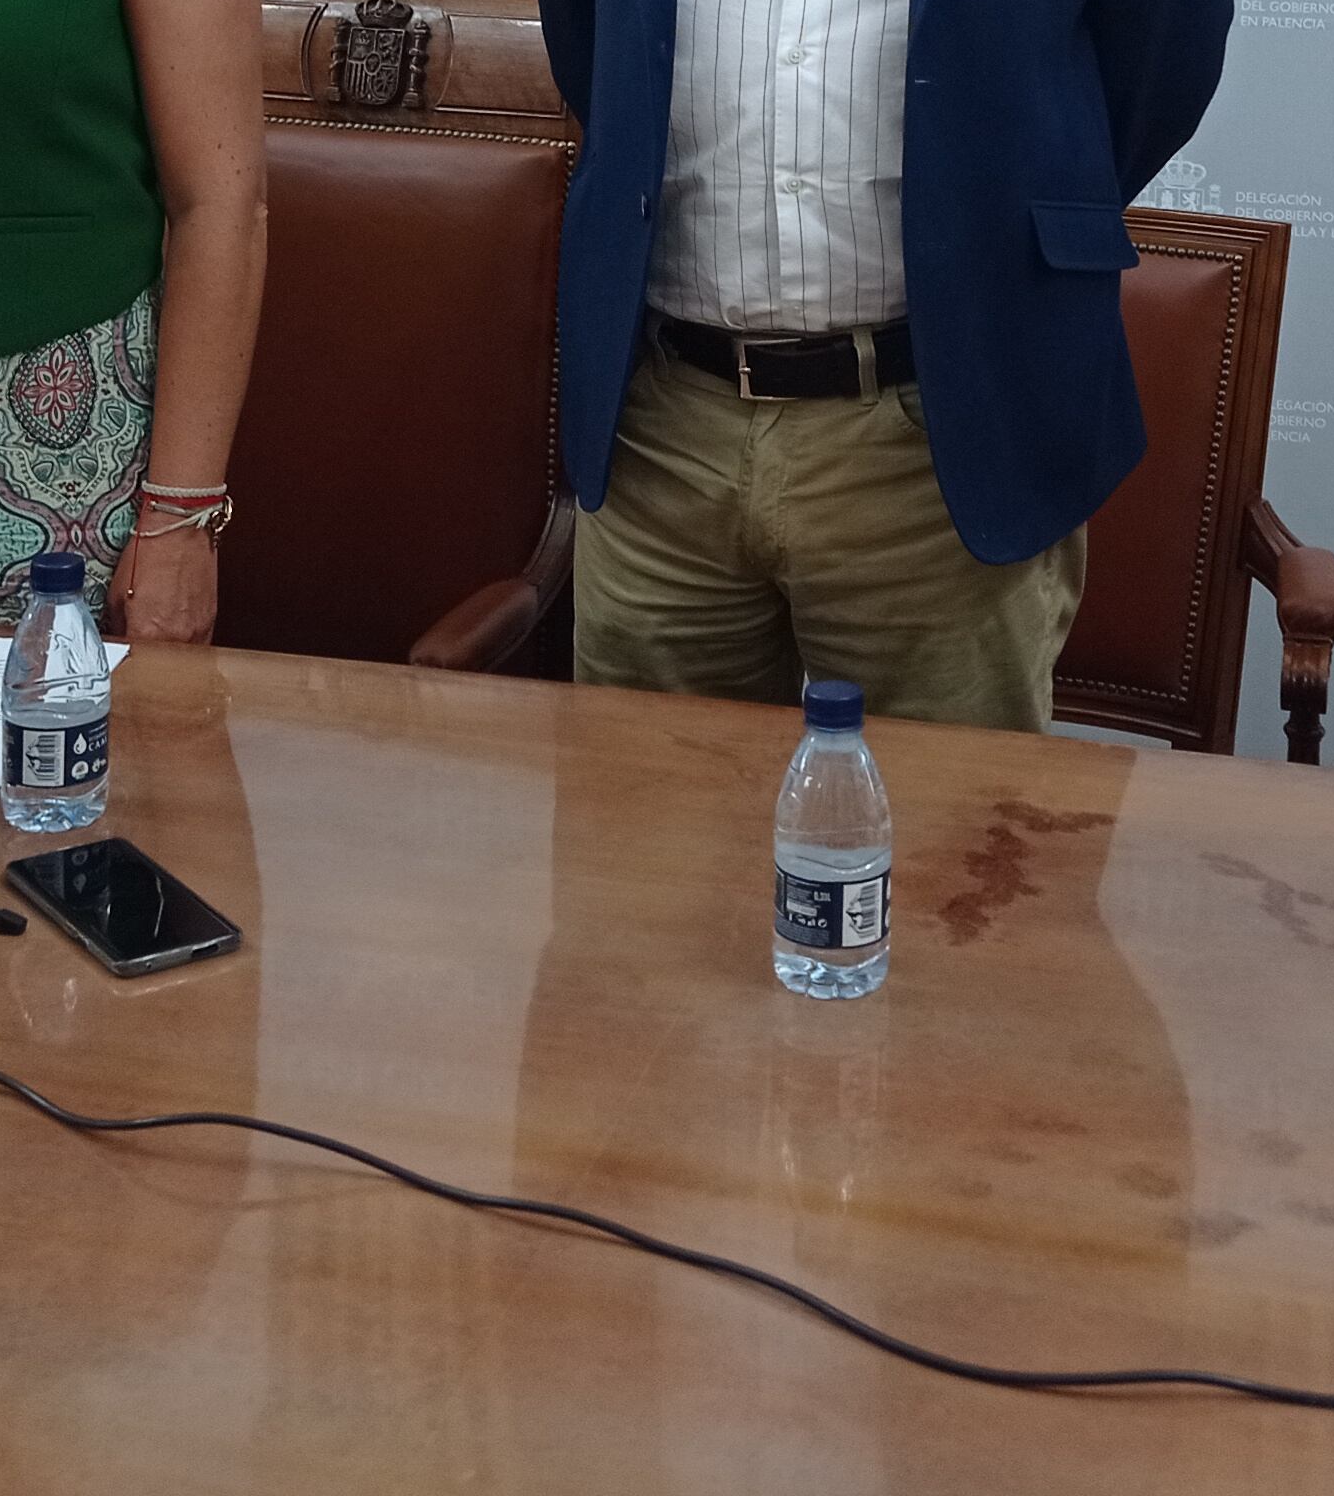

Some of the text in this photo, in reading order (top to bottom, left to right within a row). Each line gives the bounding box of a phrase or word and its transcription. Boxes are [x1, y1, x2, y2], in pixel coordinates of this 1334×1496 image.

[1241, 0, 1266, 12] DEL
[1240, 15, 1326, 30] EN PALENCIA
[1235, 190, 1323, 206] DELEGACIÓN
[1234, 206, 1334, 223] DEL GOBIERNO
[1269, 415, 1327, 429] OBIERNO
[1268, 430, 1312, 443] ENCIA
